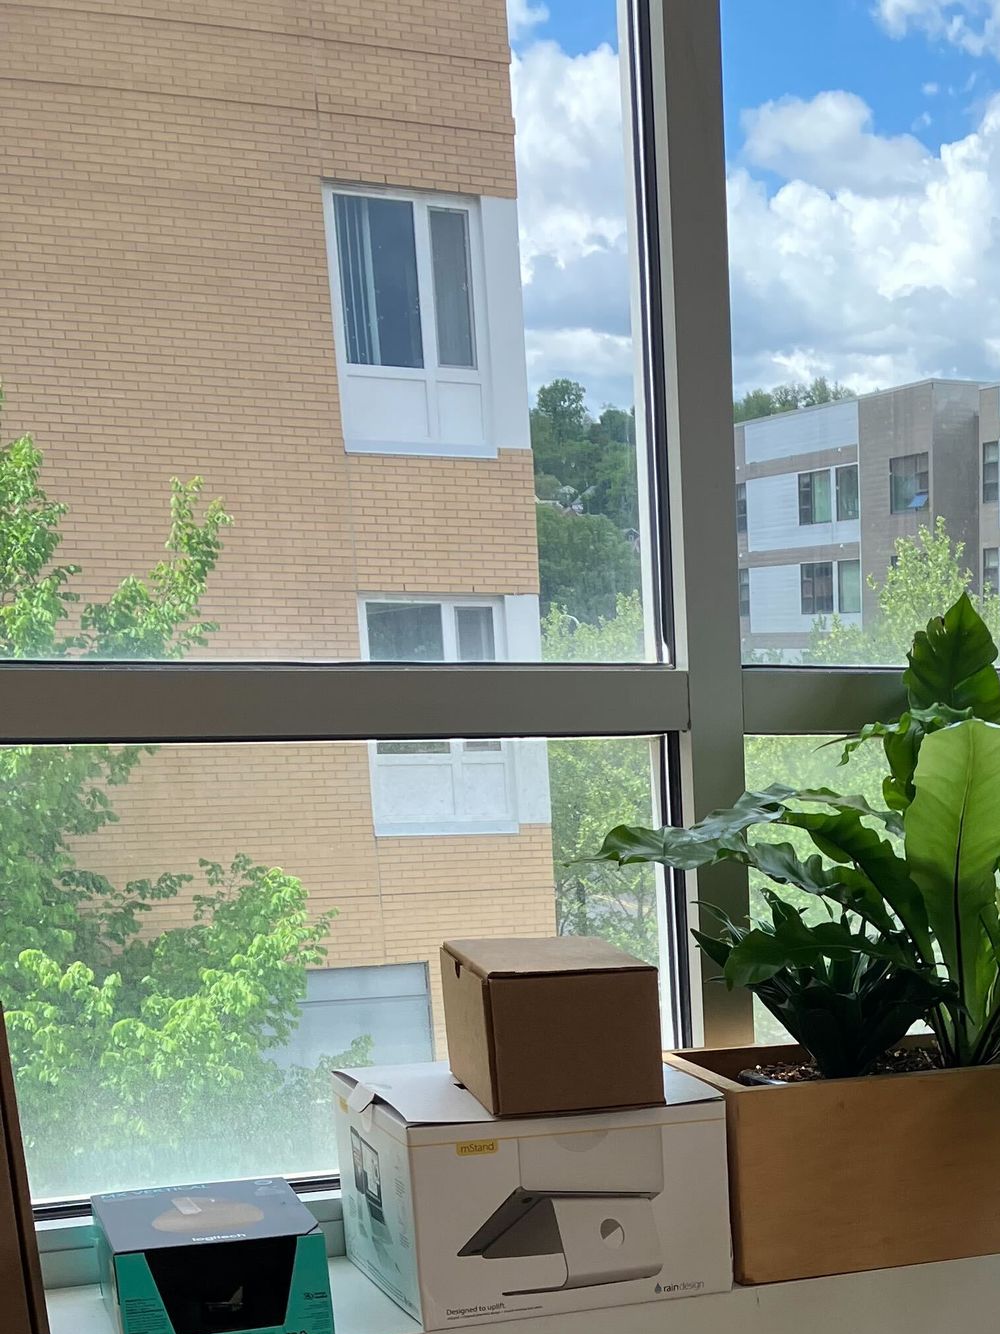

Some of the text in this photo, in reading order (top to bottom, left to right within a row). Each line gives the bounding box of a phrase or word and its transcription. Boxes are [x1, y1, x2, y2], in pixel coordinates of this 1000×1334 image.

[460, 1142, 494, 1153] mStand
[192, 1233, 247, 1243] logitech
[446, 1304, 478, 1316] Designed
